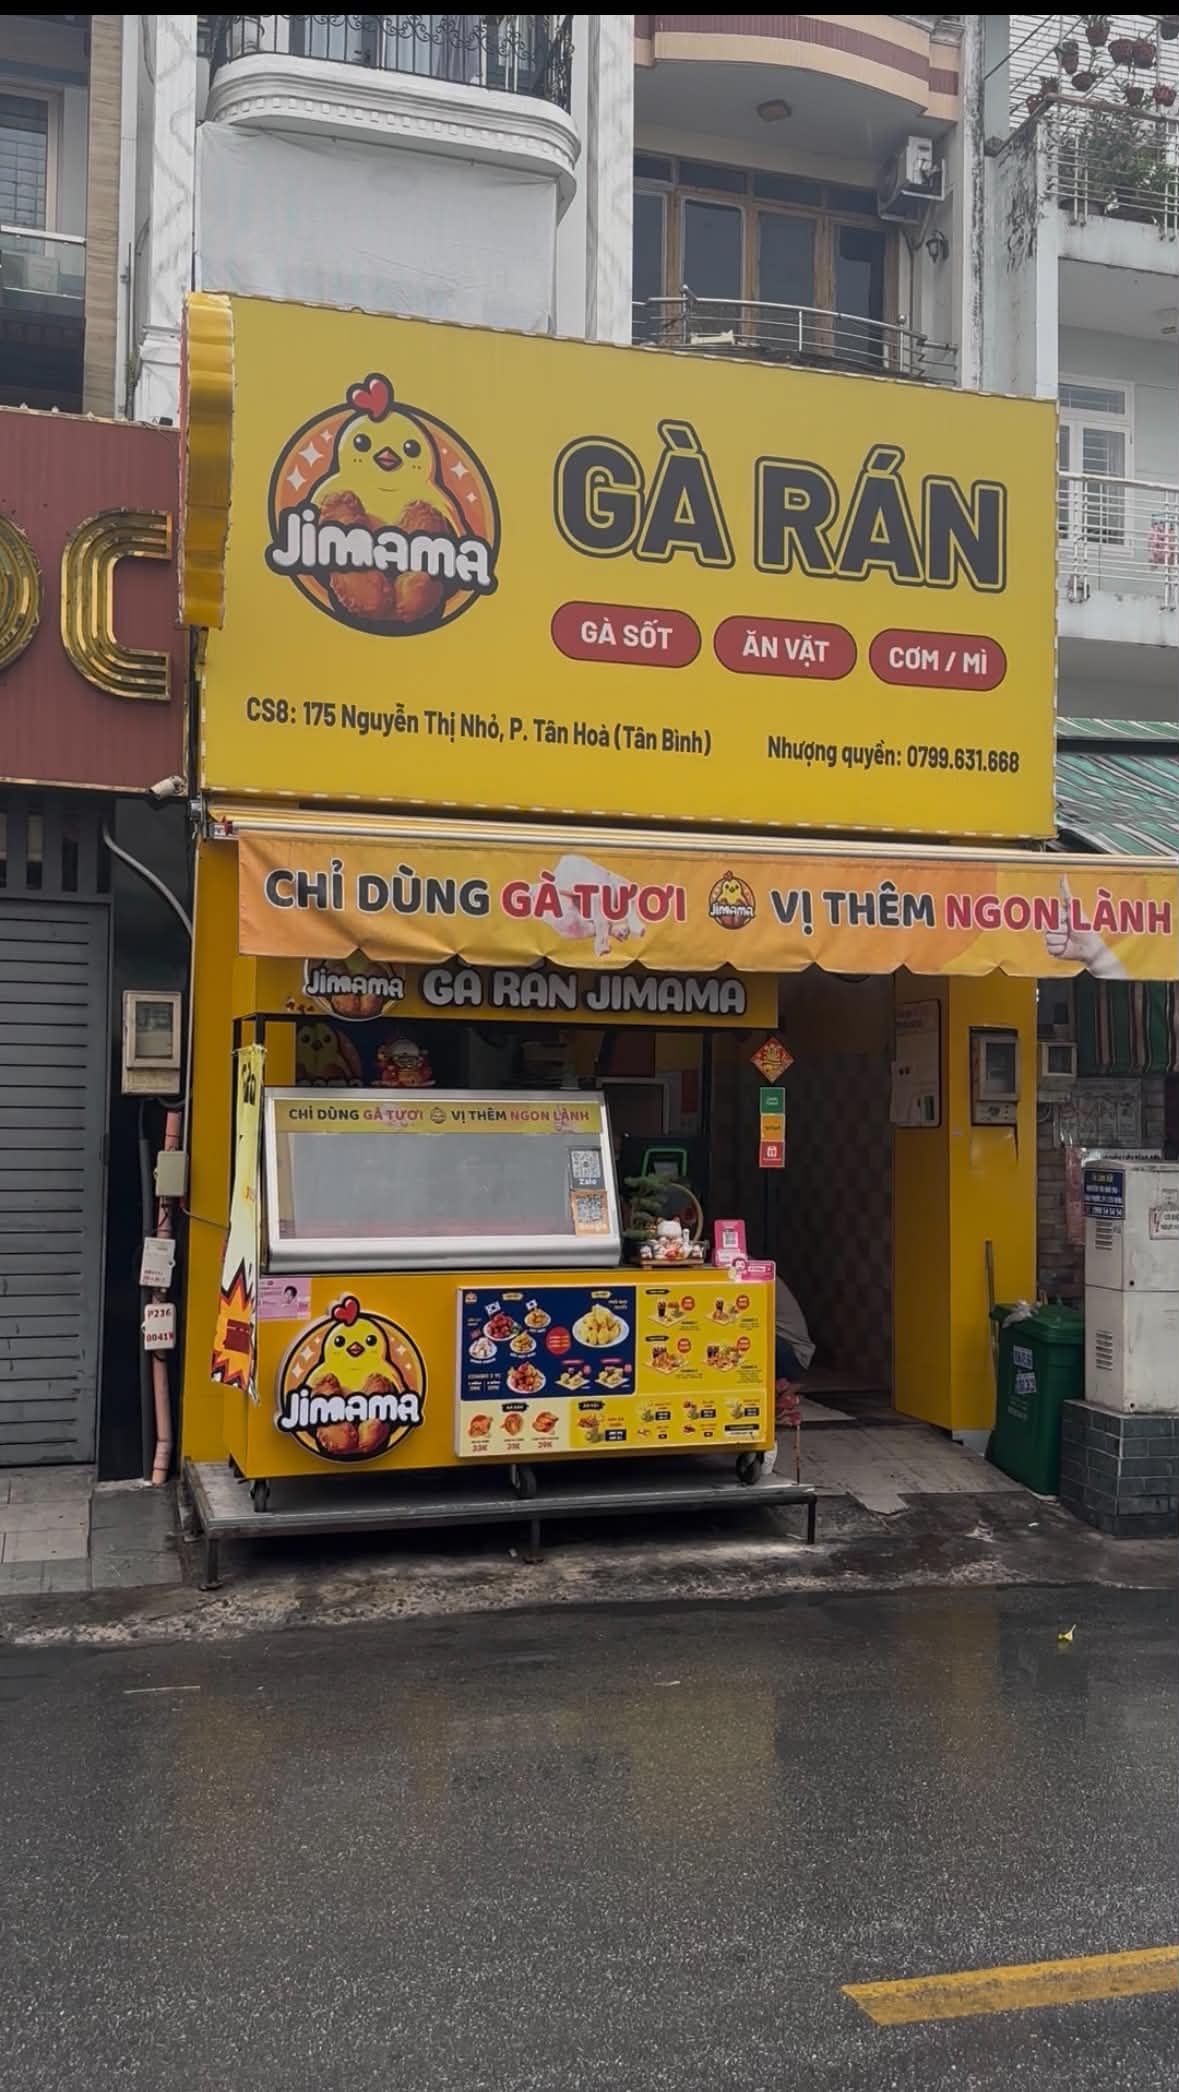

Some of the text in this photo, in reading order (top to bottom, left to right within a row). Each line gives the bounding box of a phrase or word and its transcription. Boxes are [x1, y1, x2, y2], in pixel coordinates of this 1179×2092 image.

[554, 418, 1007, 593] GÀ RÁN
[271, 508, 491, 586] Jimama
[580, 617, 673, 650] GÀ SỐT
[742, 630, 830, 667] ĂN VẶT
[888, 646, 939, 672] CƠM
[963, 648, 989, 674] MÌ
[246, 696, 712, 756] CS8: 175 Nguyễn Thị Nhỏ, P. Tân Hoà (Tân Bình)
[768, 735, 1019, 773] Nhượng quyền: 0799.631.668
[264, 858, 688, 923] CHỈ DÙNG GÀ TƯƠI
[769, 880, 1172, 935] VỊ THÊM NGON LÀNH
[306, 968, 404, 998] Jimama
[586, 975, 747, 1015] JIMAMA
[289, 1105, 423, 1120] CHỈ DÙNG GÀ TƯƠI
[451, 1107, 589, 1124] VỊ THÊM NGON LÀNH
[280, 1388, 420, 1429] Jimama
